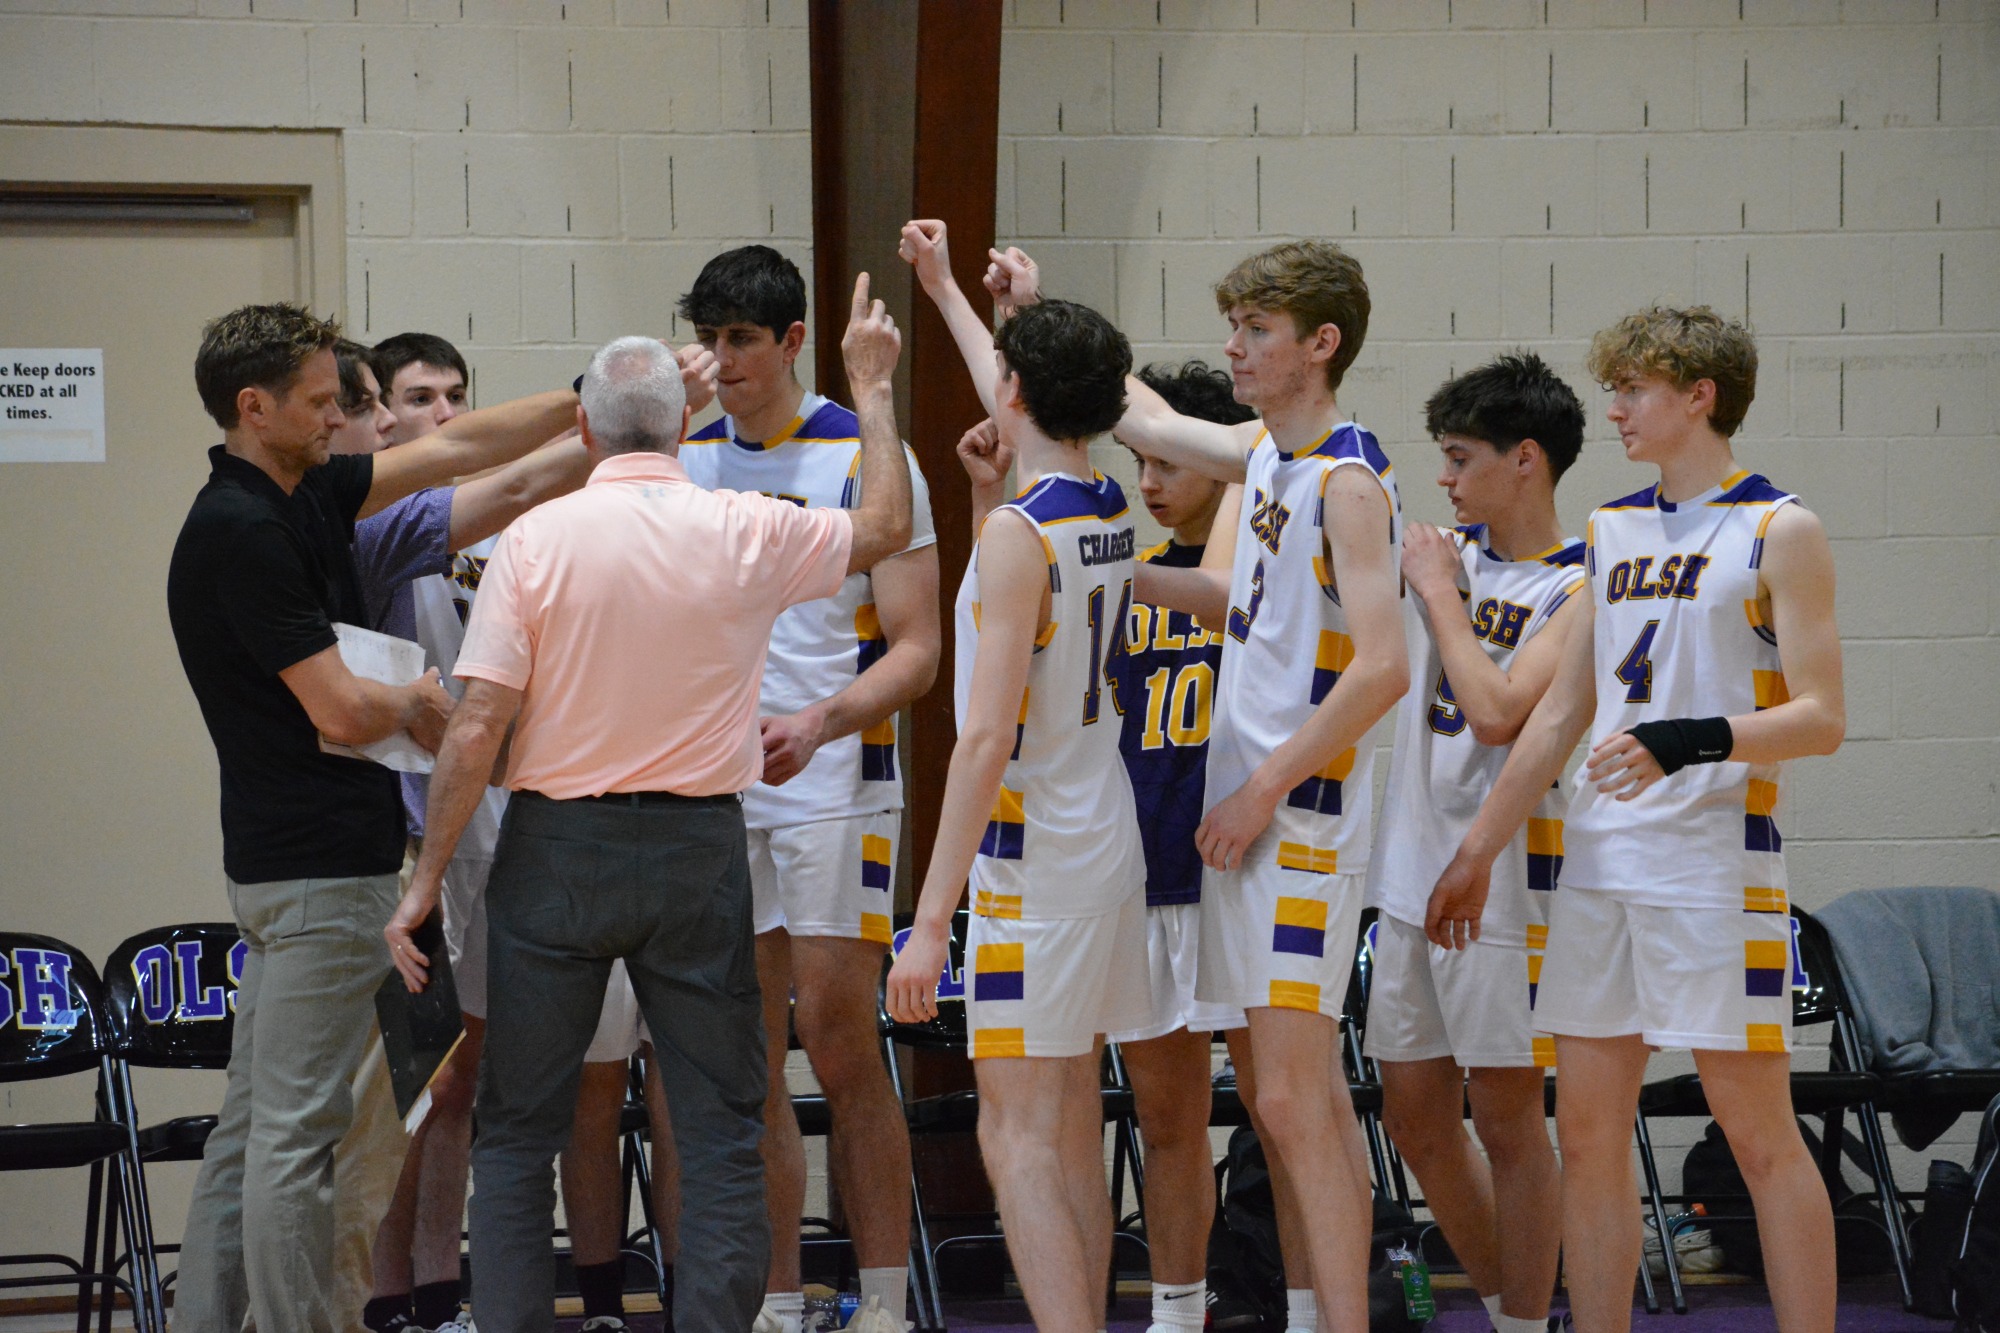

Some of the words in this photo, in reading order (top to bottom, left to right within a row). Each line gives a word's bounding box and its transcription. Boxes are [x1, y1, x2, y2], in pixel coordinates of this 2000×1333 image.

[13, 362, 49, 380] Keep
[54, 362, 96, 376] doors
[40, 386, 54, 397] at
[59, 384, 77, 397] all
[6, 405, 52, 419] times.
[1607, 553, 1712, 605] OLSH
[1082, 578, 1132, 727] 14
[1614, 619, 1660, 703] 4
[1142, 661, 1214, 751] 10
